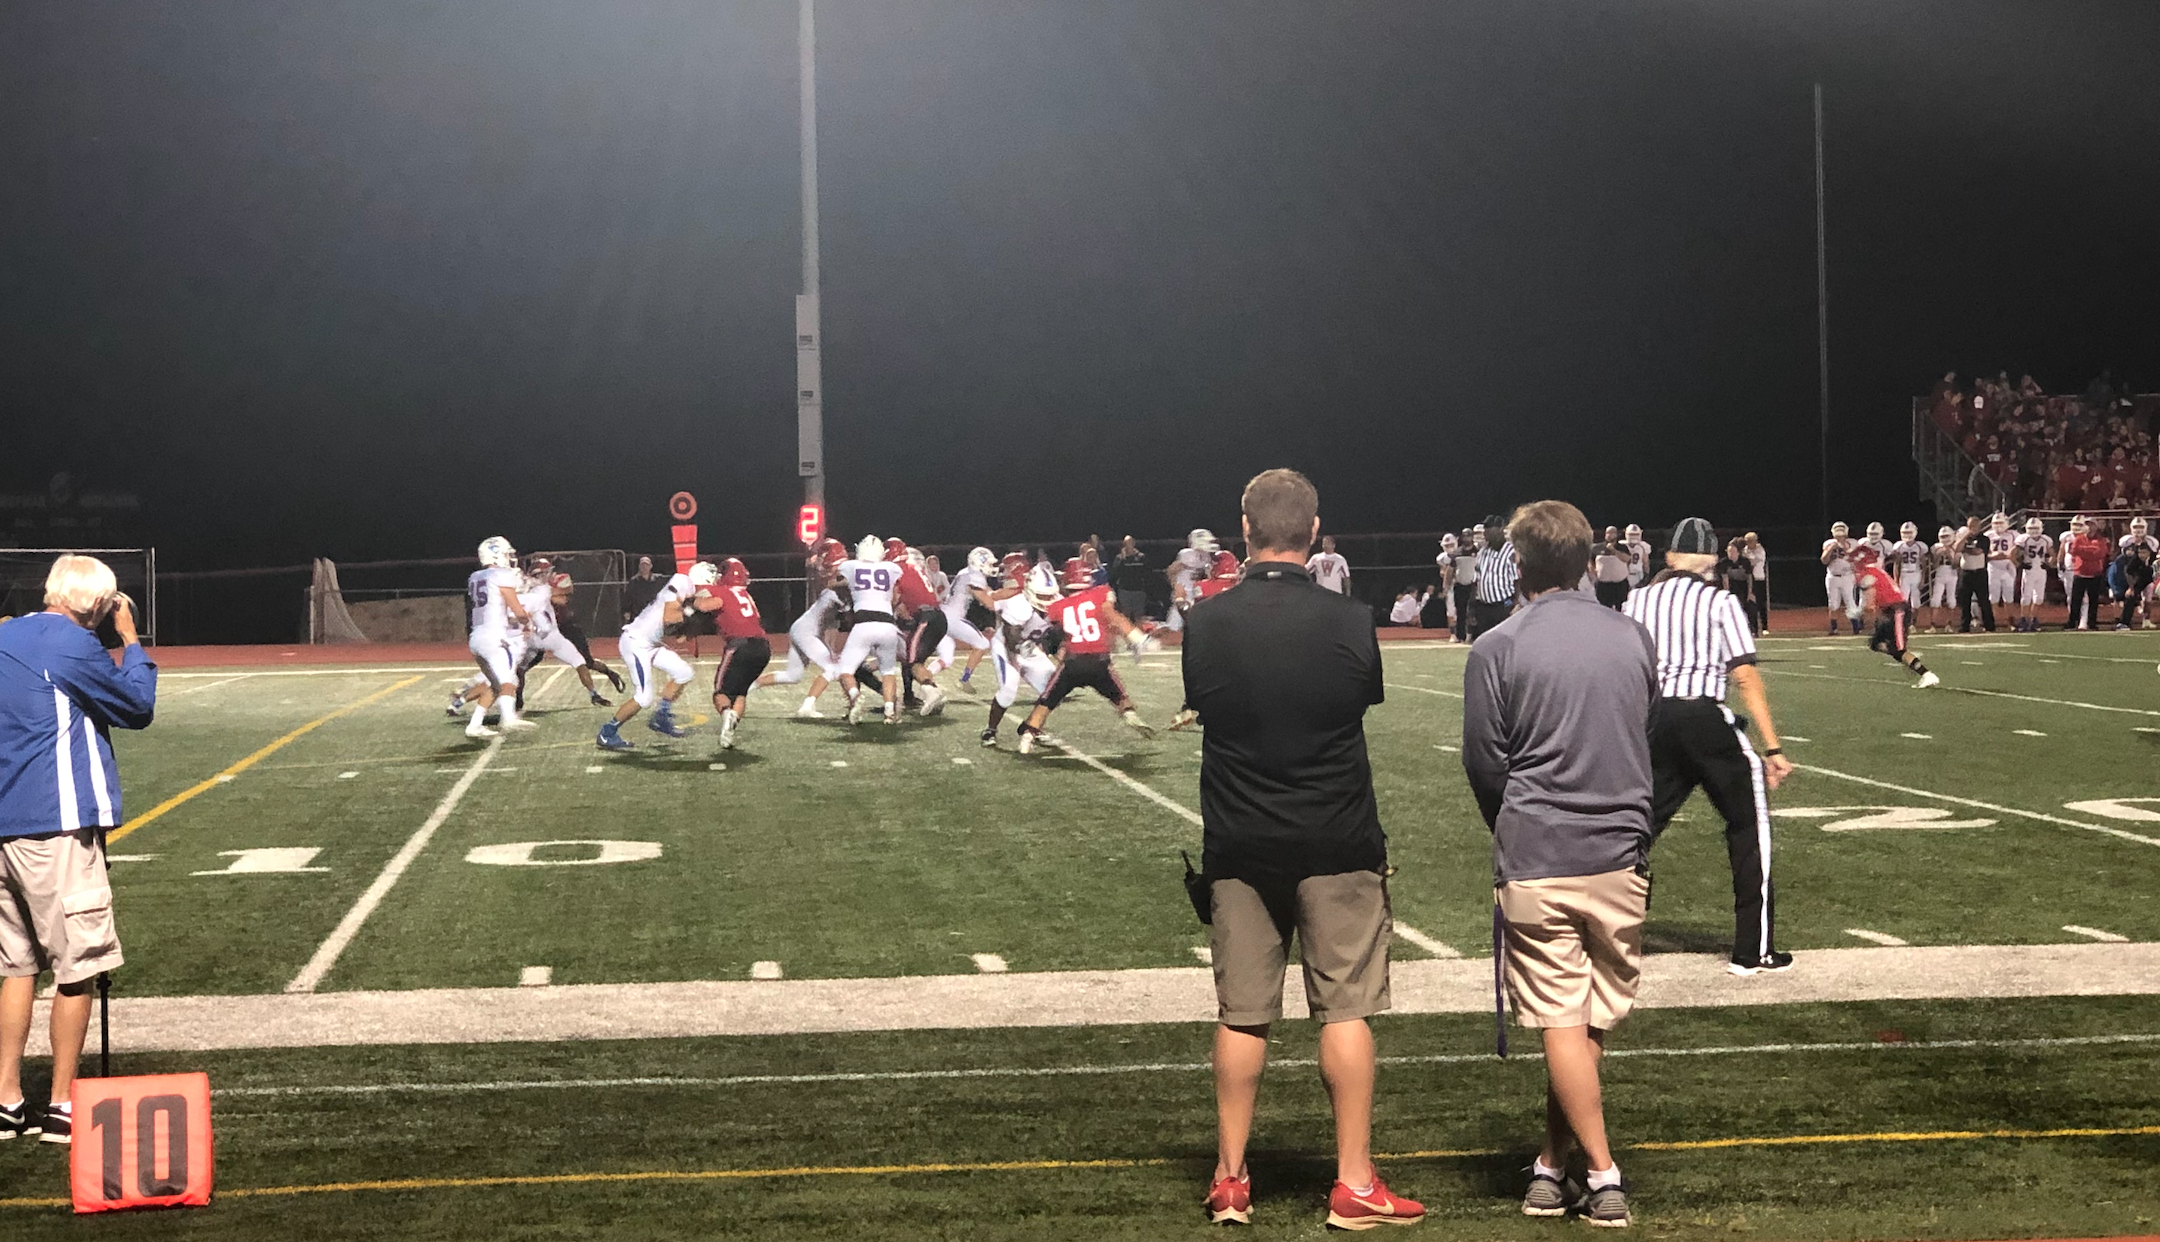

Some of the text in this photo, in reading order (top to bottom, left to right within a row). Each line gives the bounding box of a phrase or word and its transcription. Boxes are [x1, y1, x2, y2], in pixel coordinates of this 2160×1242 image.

[801, 508, 819, 540] 2
[1992, 539, 2008, 551] 76
[2028, 545, 2044, 559] 54
[853, 568, 891, 592] 59
[1321, 560, 1336, 577] W
[1062, 600, 1101, 643] 46
[91, 1094, 188, 1200] 10
